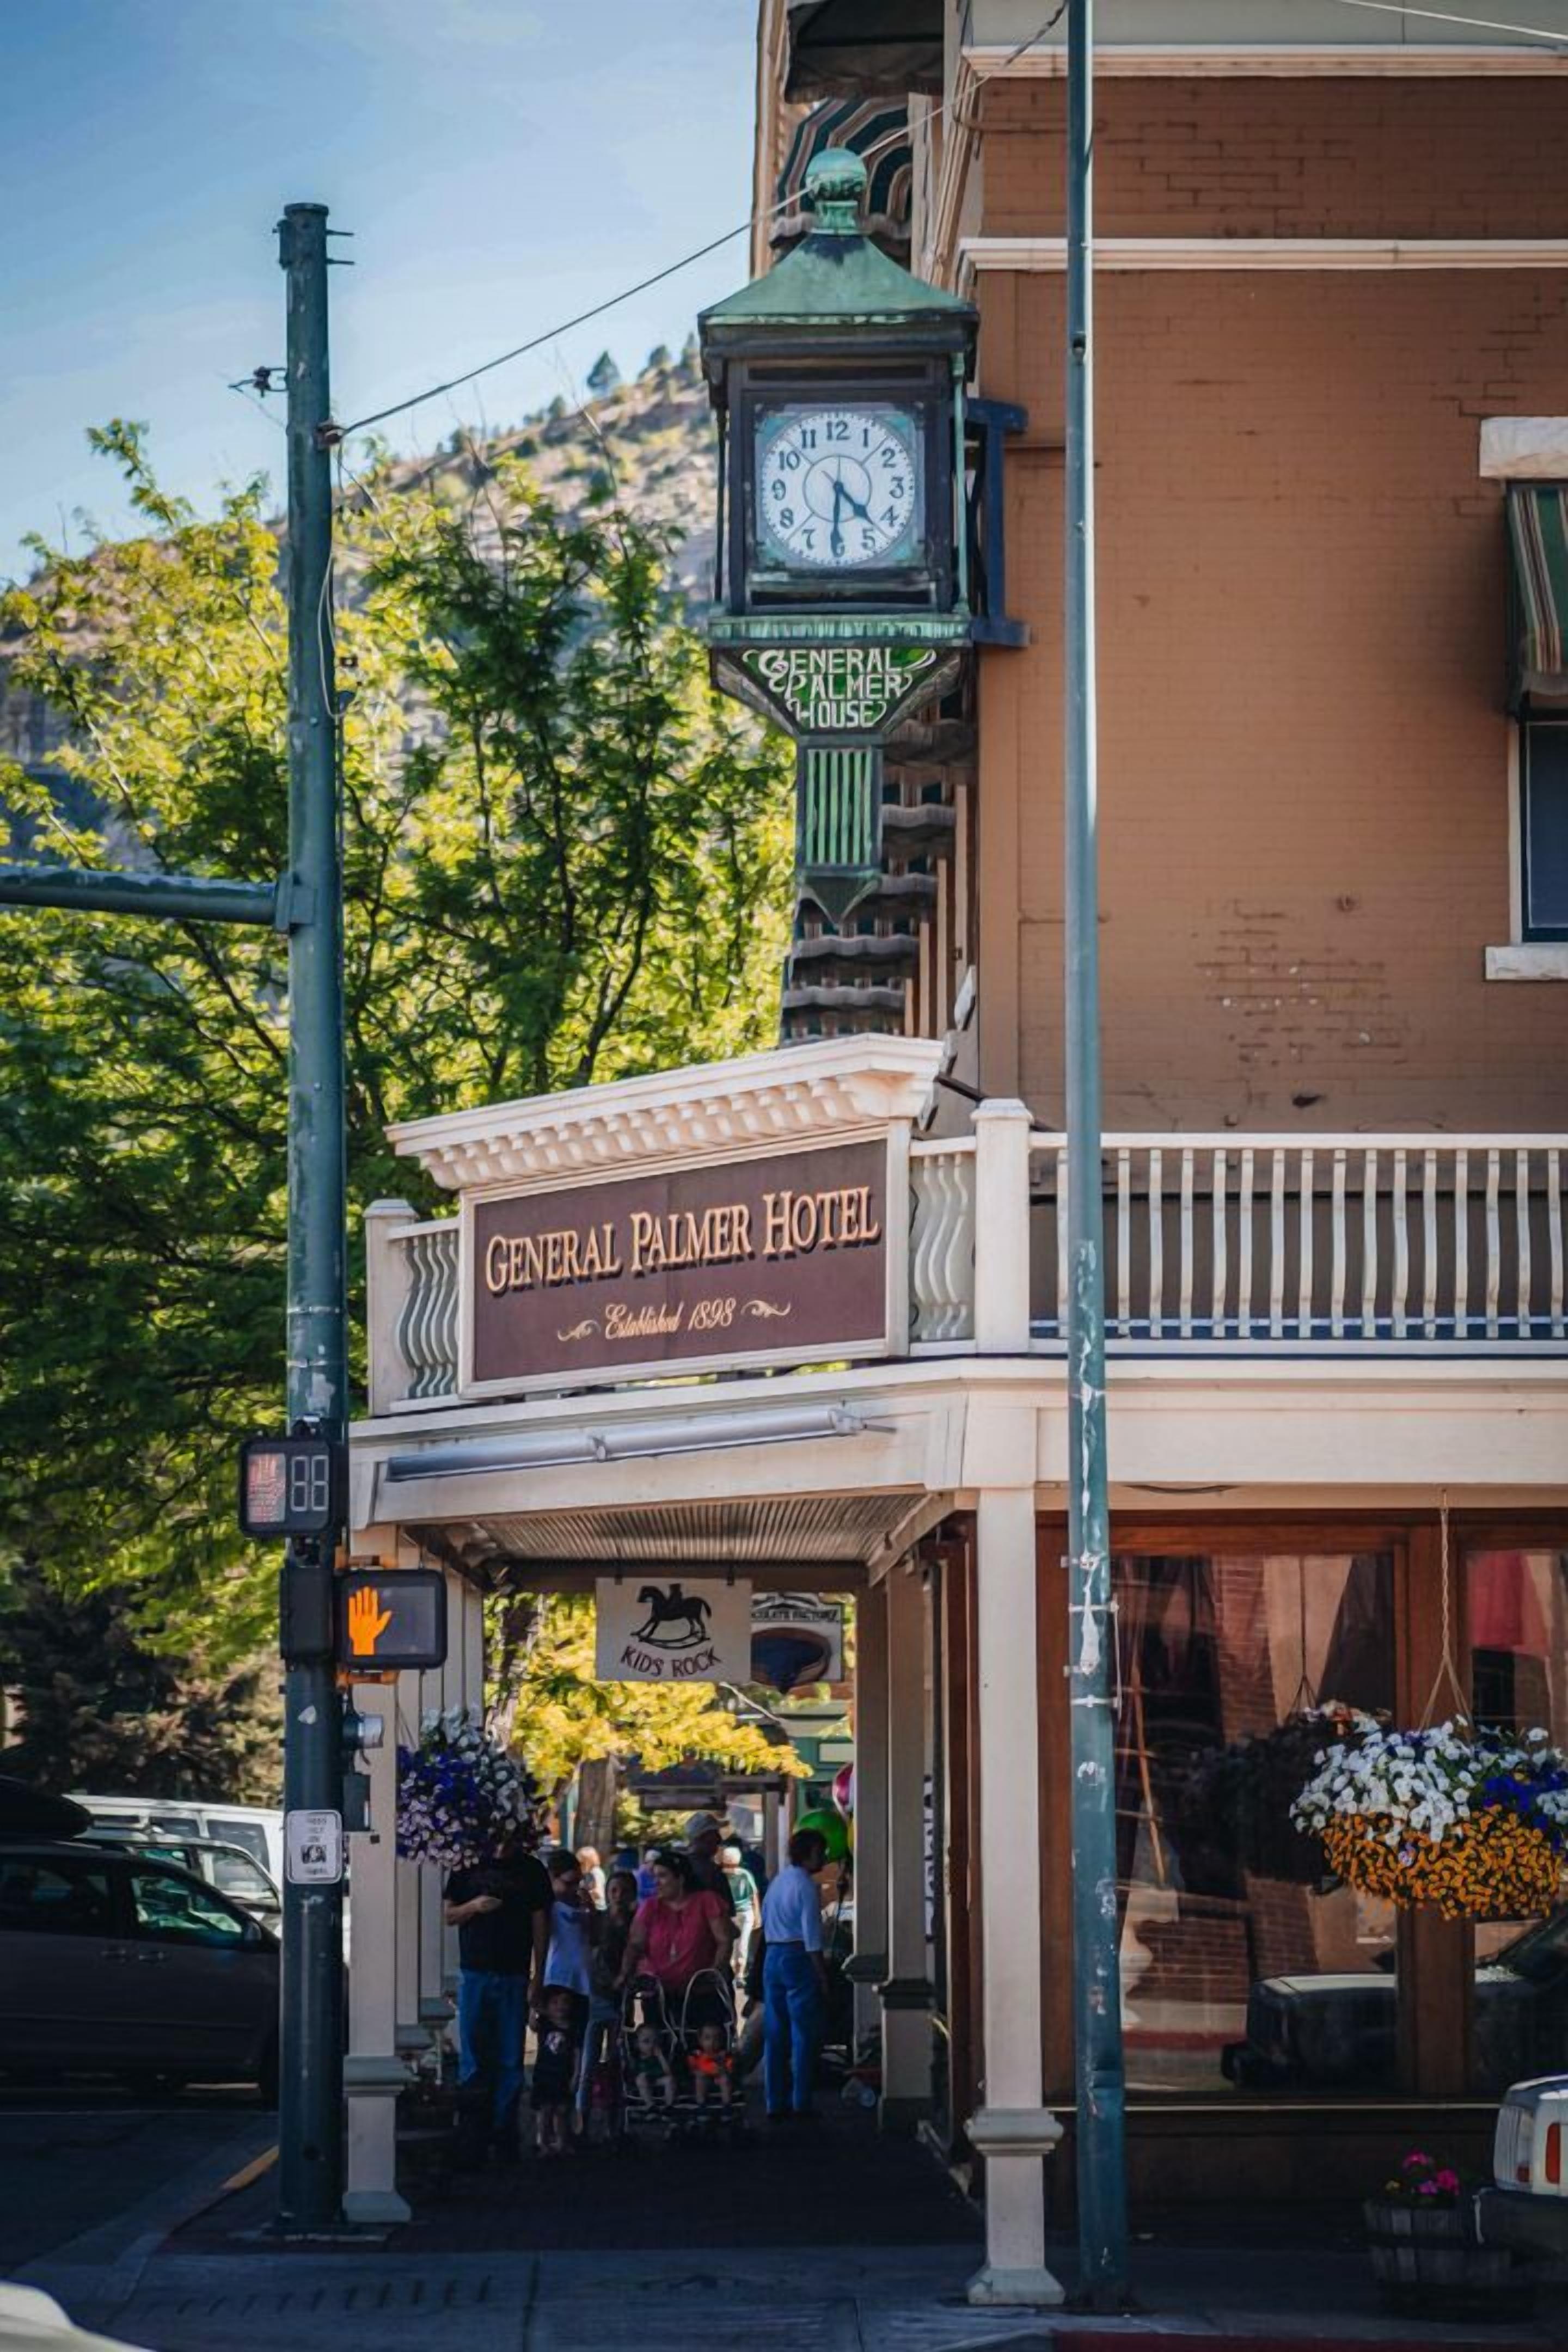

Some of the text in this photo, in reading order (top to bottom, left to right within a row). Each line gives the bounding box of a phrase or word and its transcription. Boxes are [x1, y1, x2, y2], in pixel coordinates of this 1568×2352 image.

[801, 429, 817, 449] 11
[826, 421, 850, 440] 12
[862, 428, 869, 448] 1
[779, 450, 801, 470] 10
[882, 449, 896, 468] 2
[772, 480, 786, 500] 9
[889, 477, 904, 498] 3
[780, 508, 794, 528] 8
[880, 505, 899, 528] 4
[803, 530, 816, 549] 7
[862, 529, 875, 550] 5
[742, 647, 936, 678] GENERAL
[769, 673, 912, 700] PALMER
[786, 699, 887, 728] HOUSE
[485, 1186, 879, 1293] GENERAL PALMER HOTEL
[688, 1297, 737, 1331] 1898
[620, 1646, 722, 1678] KIDS ROCK
